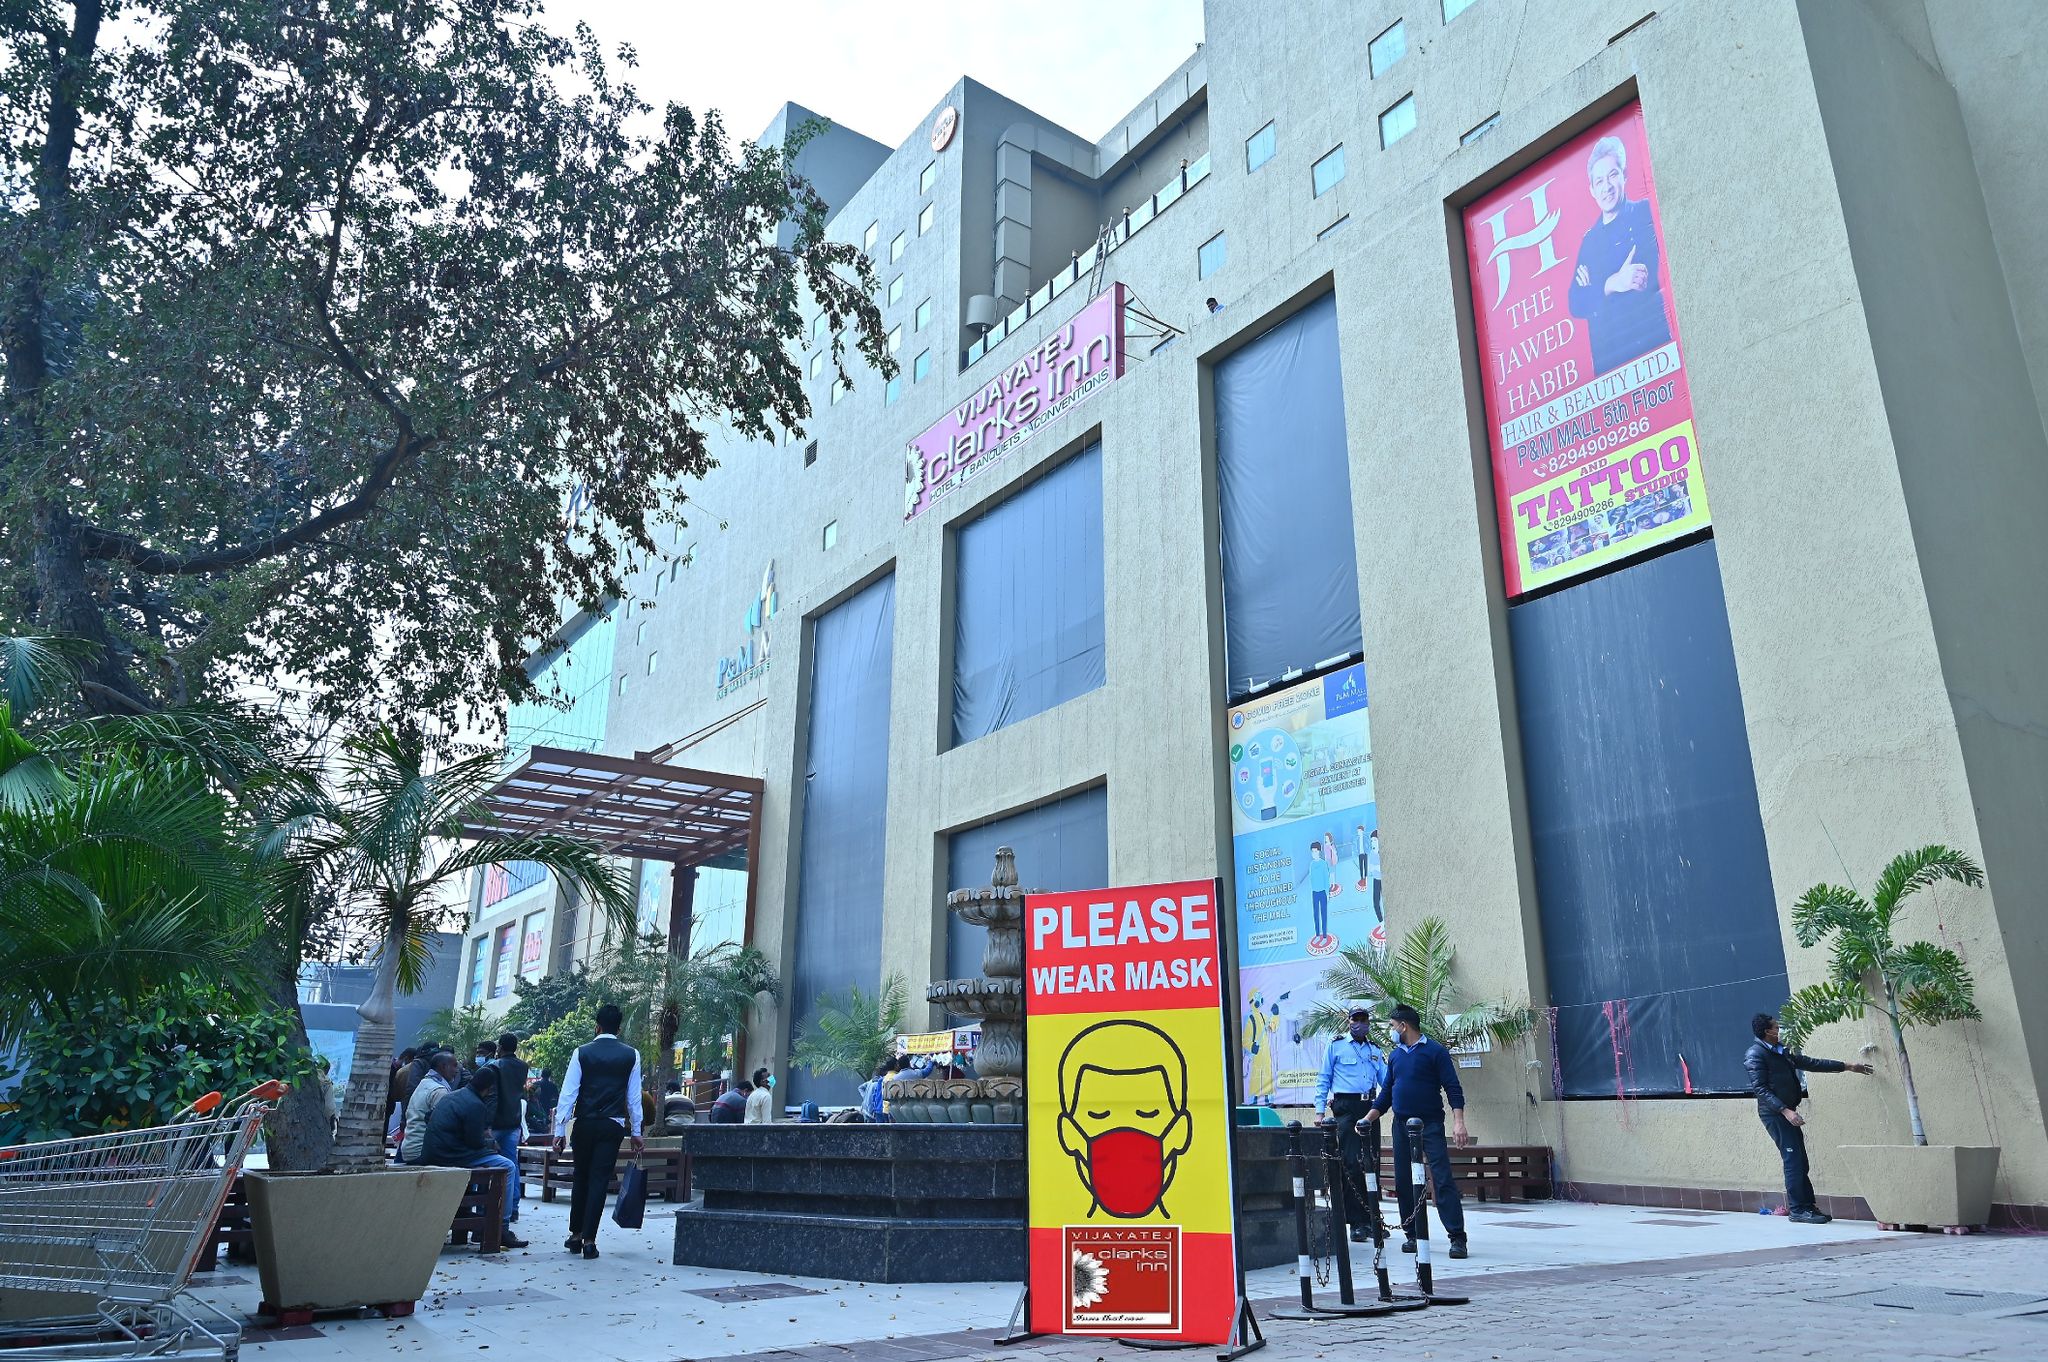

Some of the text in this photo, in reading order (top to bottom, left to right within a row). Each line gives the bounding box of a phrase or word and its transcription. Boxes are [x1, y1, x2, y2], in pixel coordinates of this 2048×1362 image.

[1506, 286, 1554, 330] THE
[1498, 318, 1575, 385] JAWED
[956, 324, 1074, 427] VIJAYATEJ
[1507, 359, 1579, 414] HABIB
[927, 334, 1110, 485] clarks inn
[1504, 351, 1675, 445] HAIR & BEAUTY LTD.
[930, 368, 1109, 501] HOTEL BANQUETS CONVENTIONS
[1517, 380, 1674, 467] P&M MALL 5th Floor
[1549, 416, 1650, 474] 8294909286
[1517, 435, 1691, 530] TATTOO
[1580, 458, 1609, 477] AND
[1624, 468, 1689, 502] STUDIO
[1553, 498, 1615, 531] 8294909286
[1246, 704, 1271, 720] COVID
[1273, 696, 1294, 711] FREE
[1296, 685, 1320, 703] ZONE
[1247, 857, 1292, 874] DISTANCING
[1254, 847, 1283, 860] SOCIAL
[1247, 882, 1293, 899] MAINTAINED
[1259, 872, 1281, 884] TO BE
[1245, 894, 1297, 912] THROUGHOUT
[1253, 909, 1290, 923] THE MALL
[1033, 895, 1211, 950] PLEASE
[1032, 957, 1213, 996] WEAR MASK
[1071, 1231, 1172, 1240] VIJAYATEJ
[1098, 1247, 1168, 1259] clarks
[1136, 1260, 1168, 1272] inn
